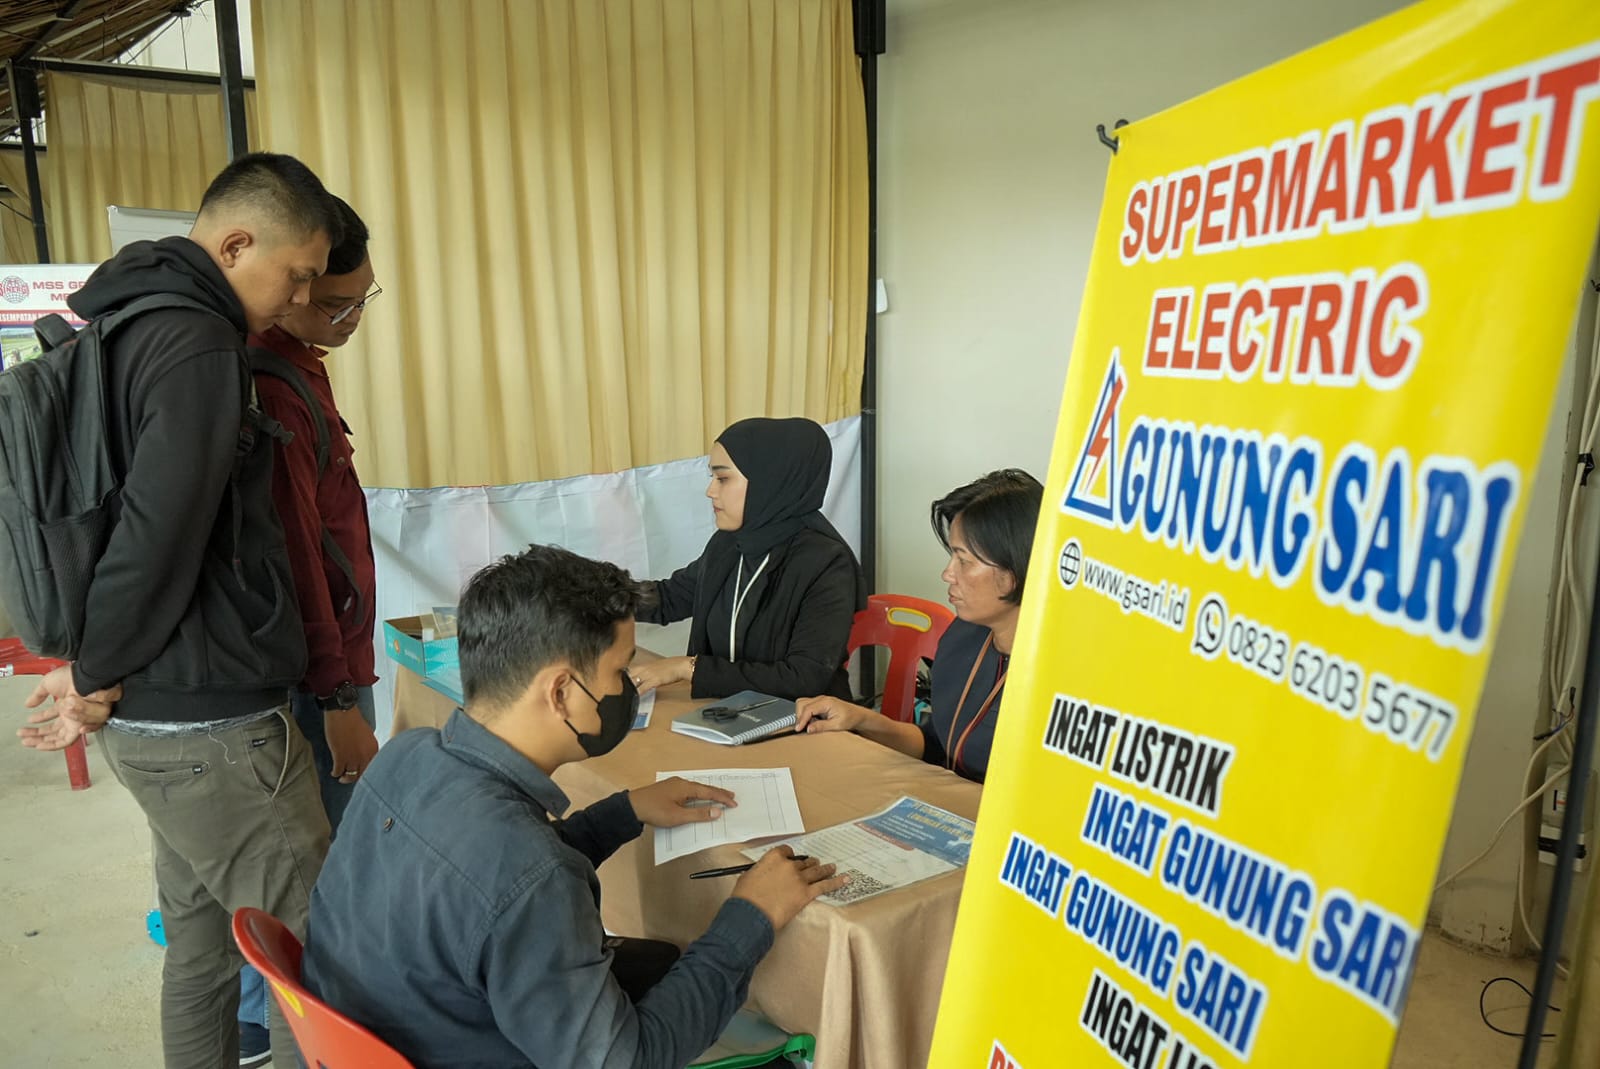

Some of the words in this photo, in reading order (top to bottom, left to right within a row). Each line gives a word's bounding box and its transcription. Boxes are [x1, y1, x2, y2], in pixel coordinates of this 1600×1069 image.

[1121, 56, 1600, 260] SUPERMARKET
[32, 281, 64, 290] MSS
[1144, 273, 1420, 378] ELECTRIC
[1083, 558, 1189, 627] www.gsari.id
[1119, 423, 1316, 578] GUNUNG
[1320, 454, 1513, 641] SARI
[1228, 624, 1288, 677] 0823
[1291, 647, 1361, 712] 6203
[1365, 679, 1455, 757] 5677
[1044, 697, 1116, 767] INGAT
[1111, 715, 1231, 812] LISTRIK
[1082, 788, 1167, 873] INGAT
[1163, 825, 1312, 954] GUNUNG
[1001, 837, 1071, 915] INGAT
[1065, 875, 1179, 993] GUNUNG
[1176, 946, 1264, 1055] SARI
[1082, 974, 1168, 1069] INGAT
